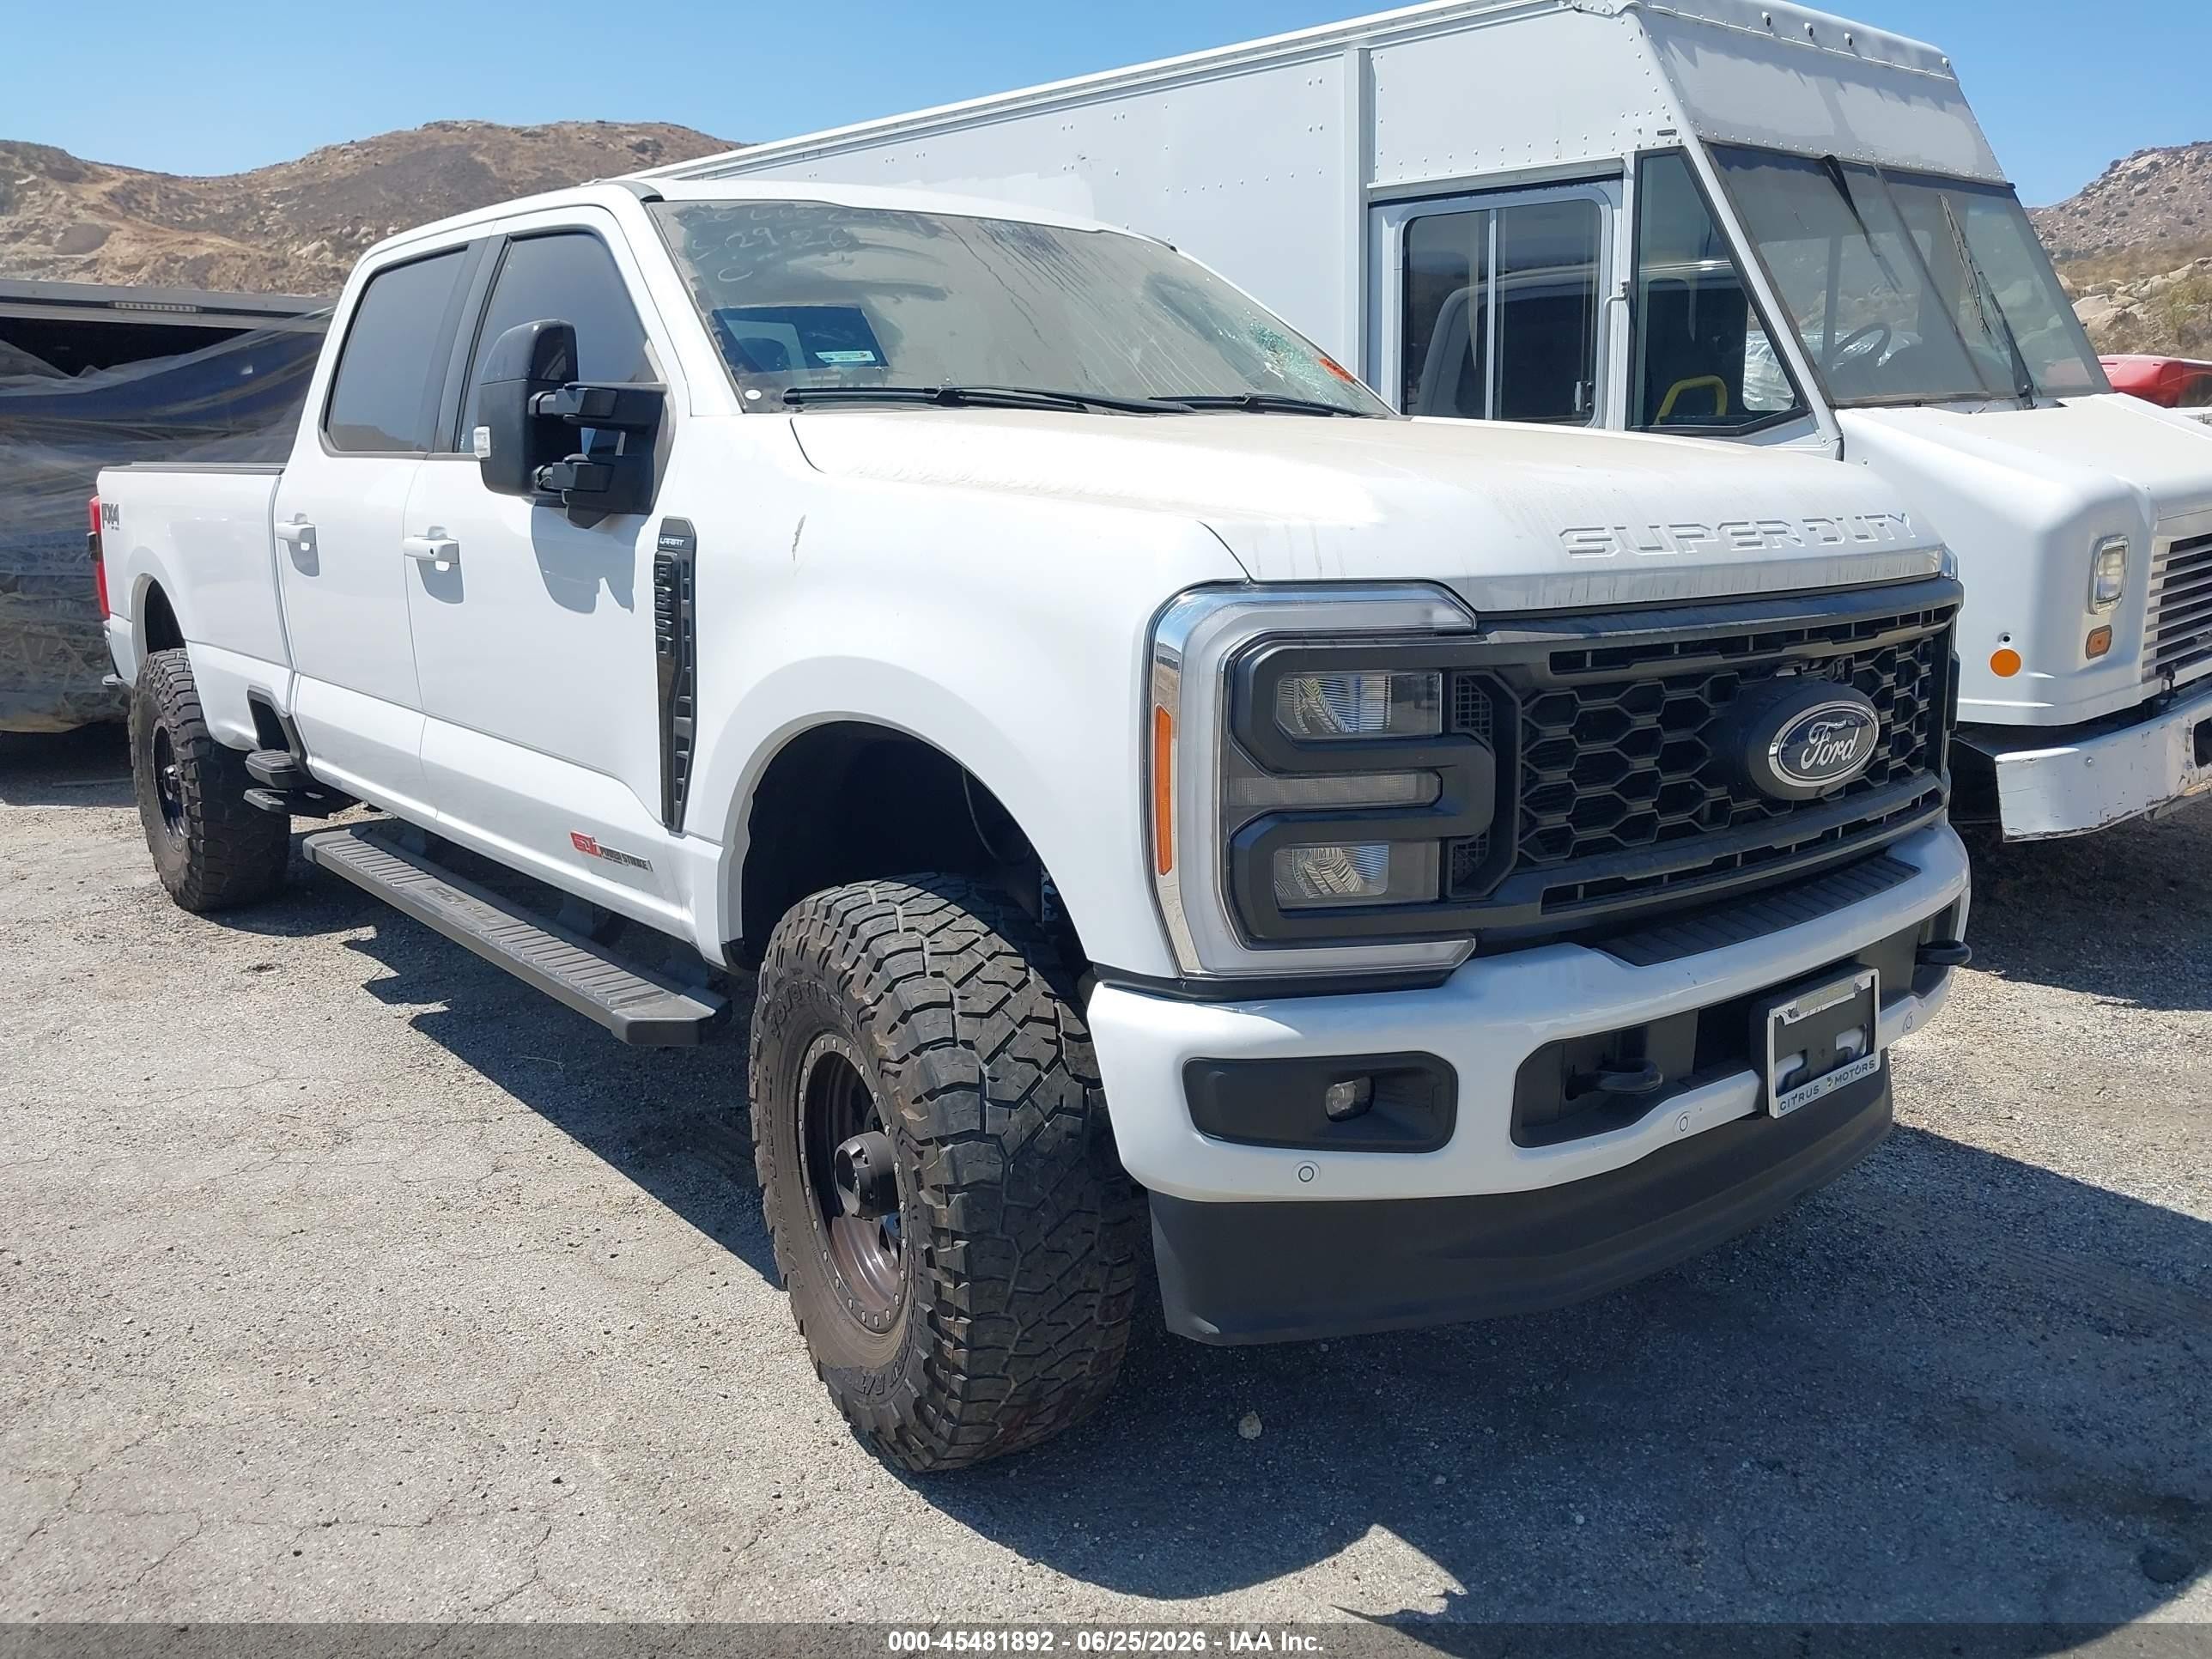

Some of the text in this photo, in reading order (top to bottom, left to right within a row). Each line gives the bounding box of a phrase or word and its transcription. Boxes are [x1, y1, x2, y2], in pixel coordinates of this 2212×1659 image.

[101, 503, 120, 529] FX4
[1559, 513, 1917, 558] SUPER DUTY
[1800, 720, 1862, 770] Ford
[1780, 1059, 1875, 1111] CITRUS MOTORS
